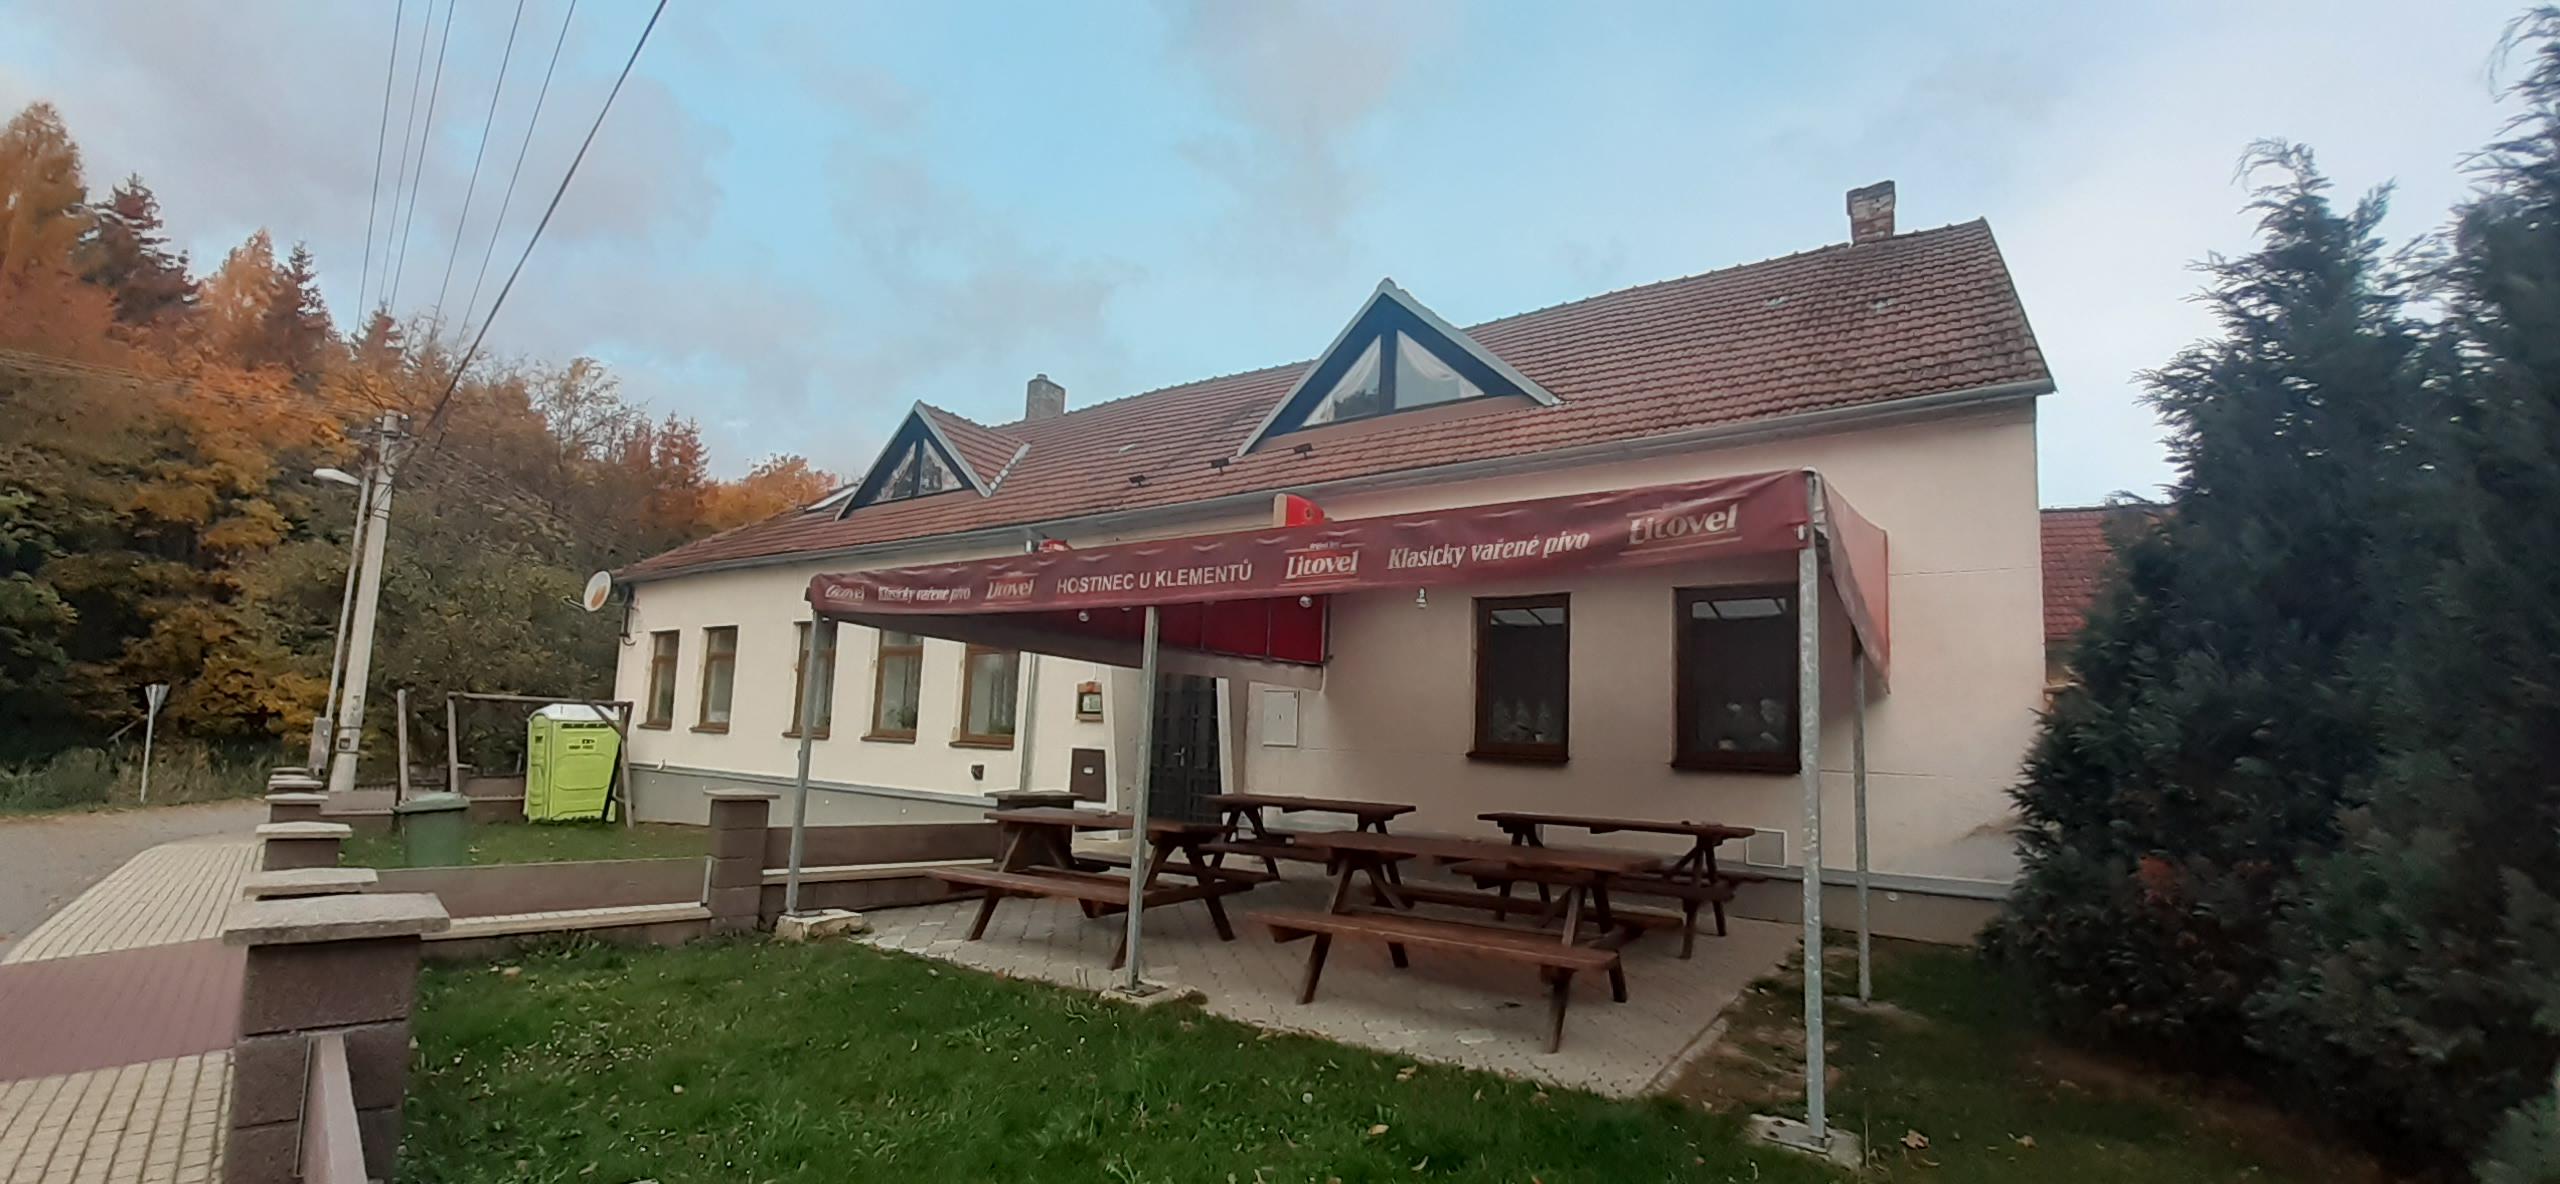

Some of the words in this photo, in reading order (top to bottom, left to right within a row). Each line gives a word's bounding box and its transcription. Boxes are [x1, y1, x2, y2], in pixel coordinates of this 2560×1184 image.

[1285, 549, 1359, 580] Litovel
[1387, 544, 1467, 570] Klasicky
[1471, 535, 1540, 563] vařené
[1542, 531, 1590, 559] pivo
[1056, 573, 1135, 595] HOSTINEC
[1139, 572, 1151, 589] U
[1154, 558, 1253, 588] KLEMENTŮ
